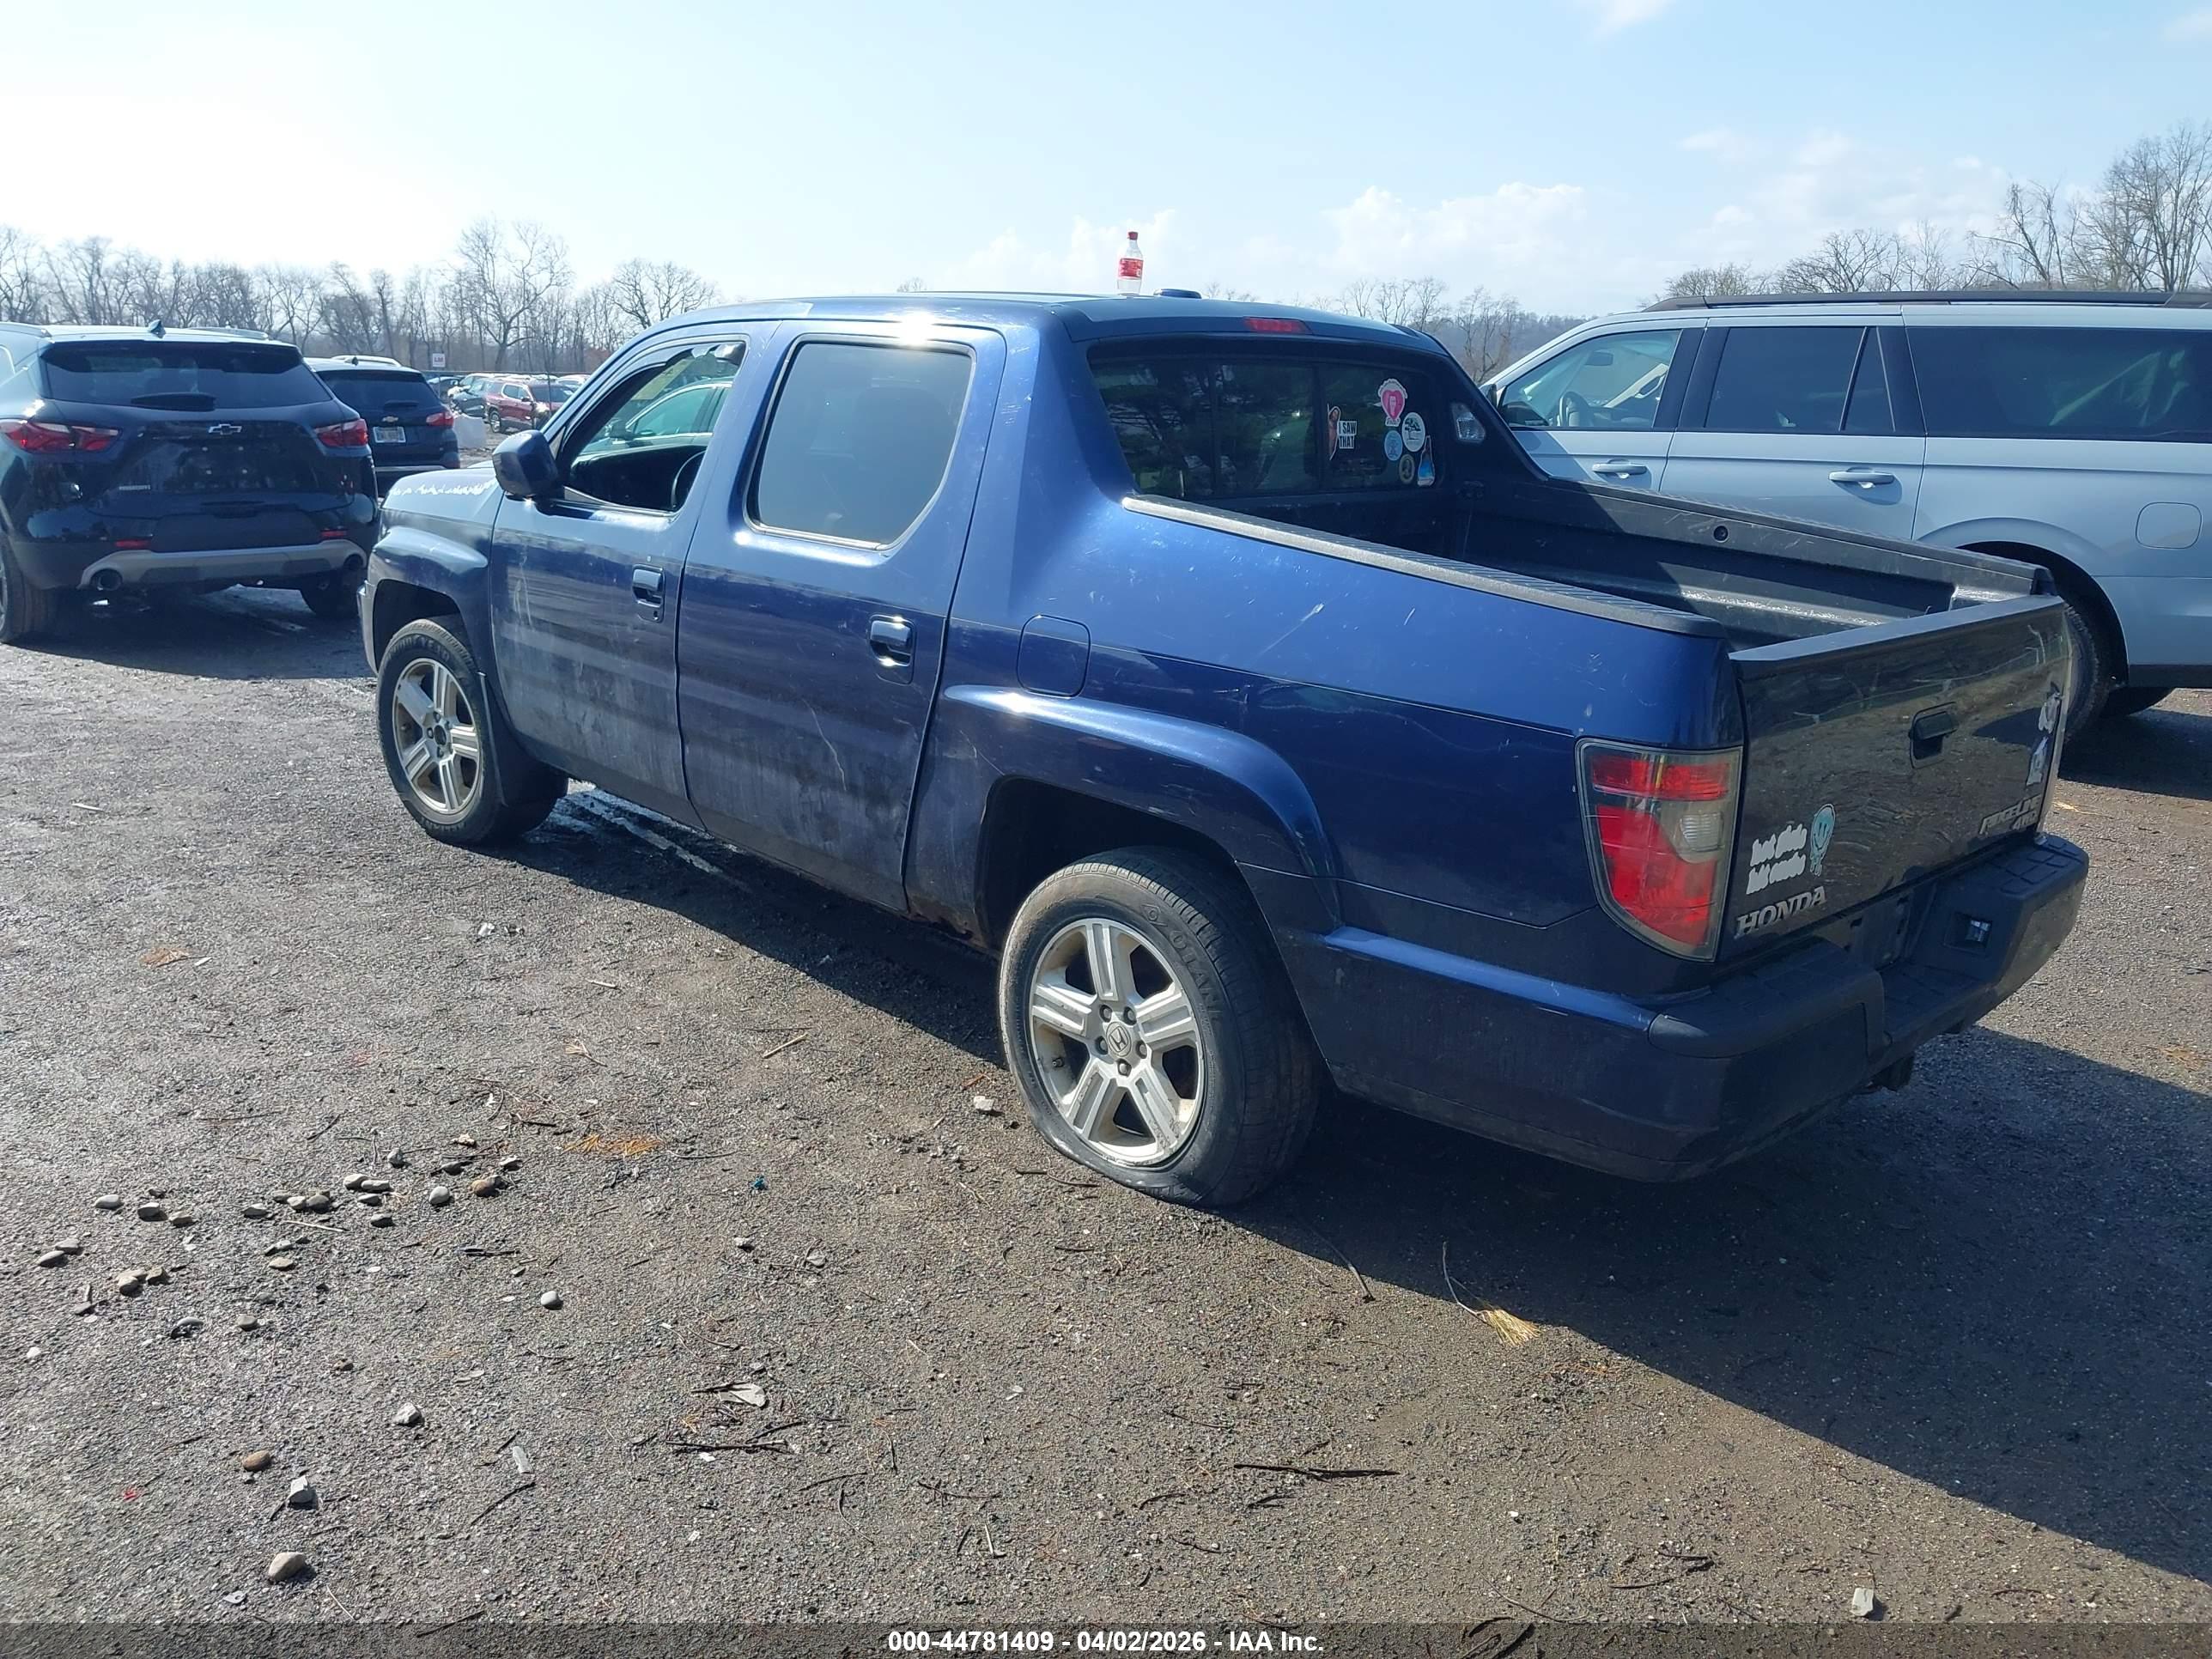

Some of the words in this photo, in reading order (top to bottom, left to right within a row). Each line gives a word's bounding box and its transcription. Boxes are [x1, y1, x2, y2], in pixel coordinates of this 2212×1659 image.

[1342, 422, 1356, 434] SAW
[1340, 435, 1354, 447] THAT
[1734, 885, 1826, 939] HONDA
